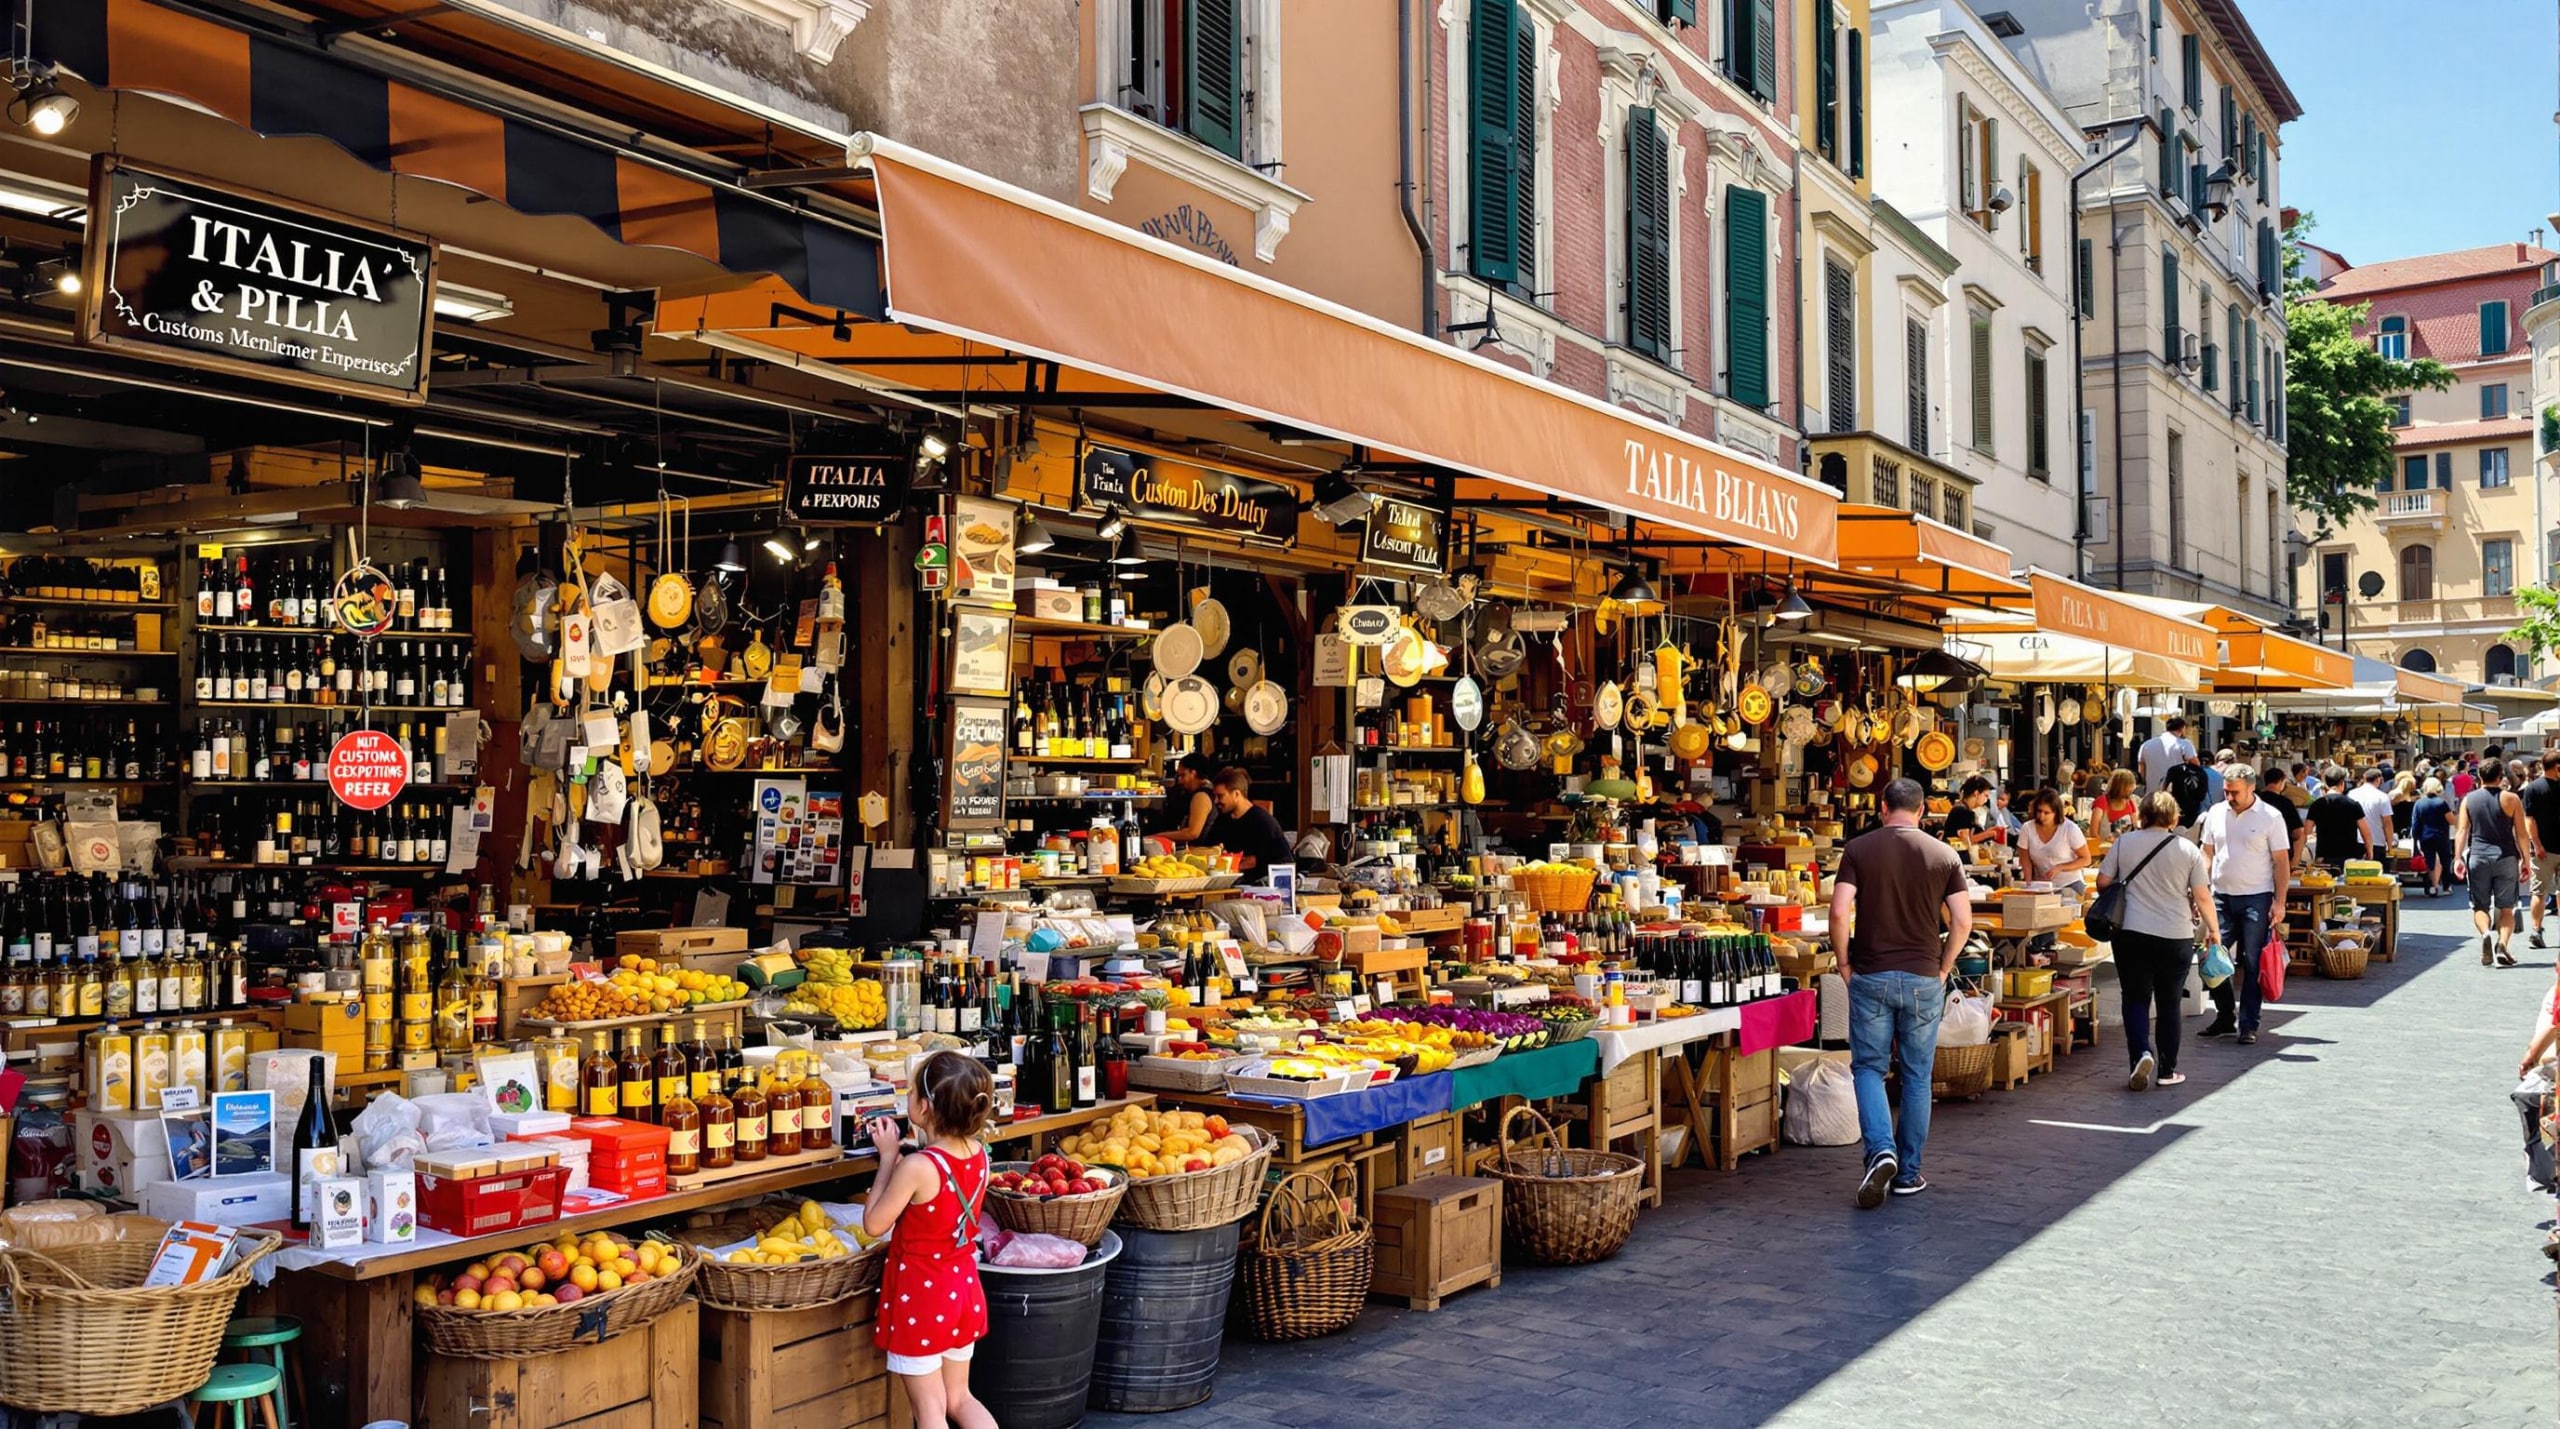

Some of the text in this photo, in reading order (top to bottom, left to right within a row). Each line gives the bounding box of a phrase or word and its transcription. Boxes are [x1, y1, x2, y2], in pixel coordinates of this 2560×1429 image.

[191, 279, 358, 342] & PILIA
[143, 312, 224, 344] Customs
[808, 465, 886, 487] ITALIA
[1624, 439, 1799, 541] TALIA BLIANS
[1189, 479, 1218, 513] Des
